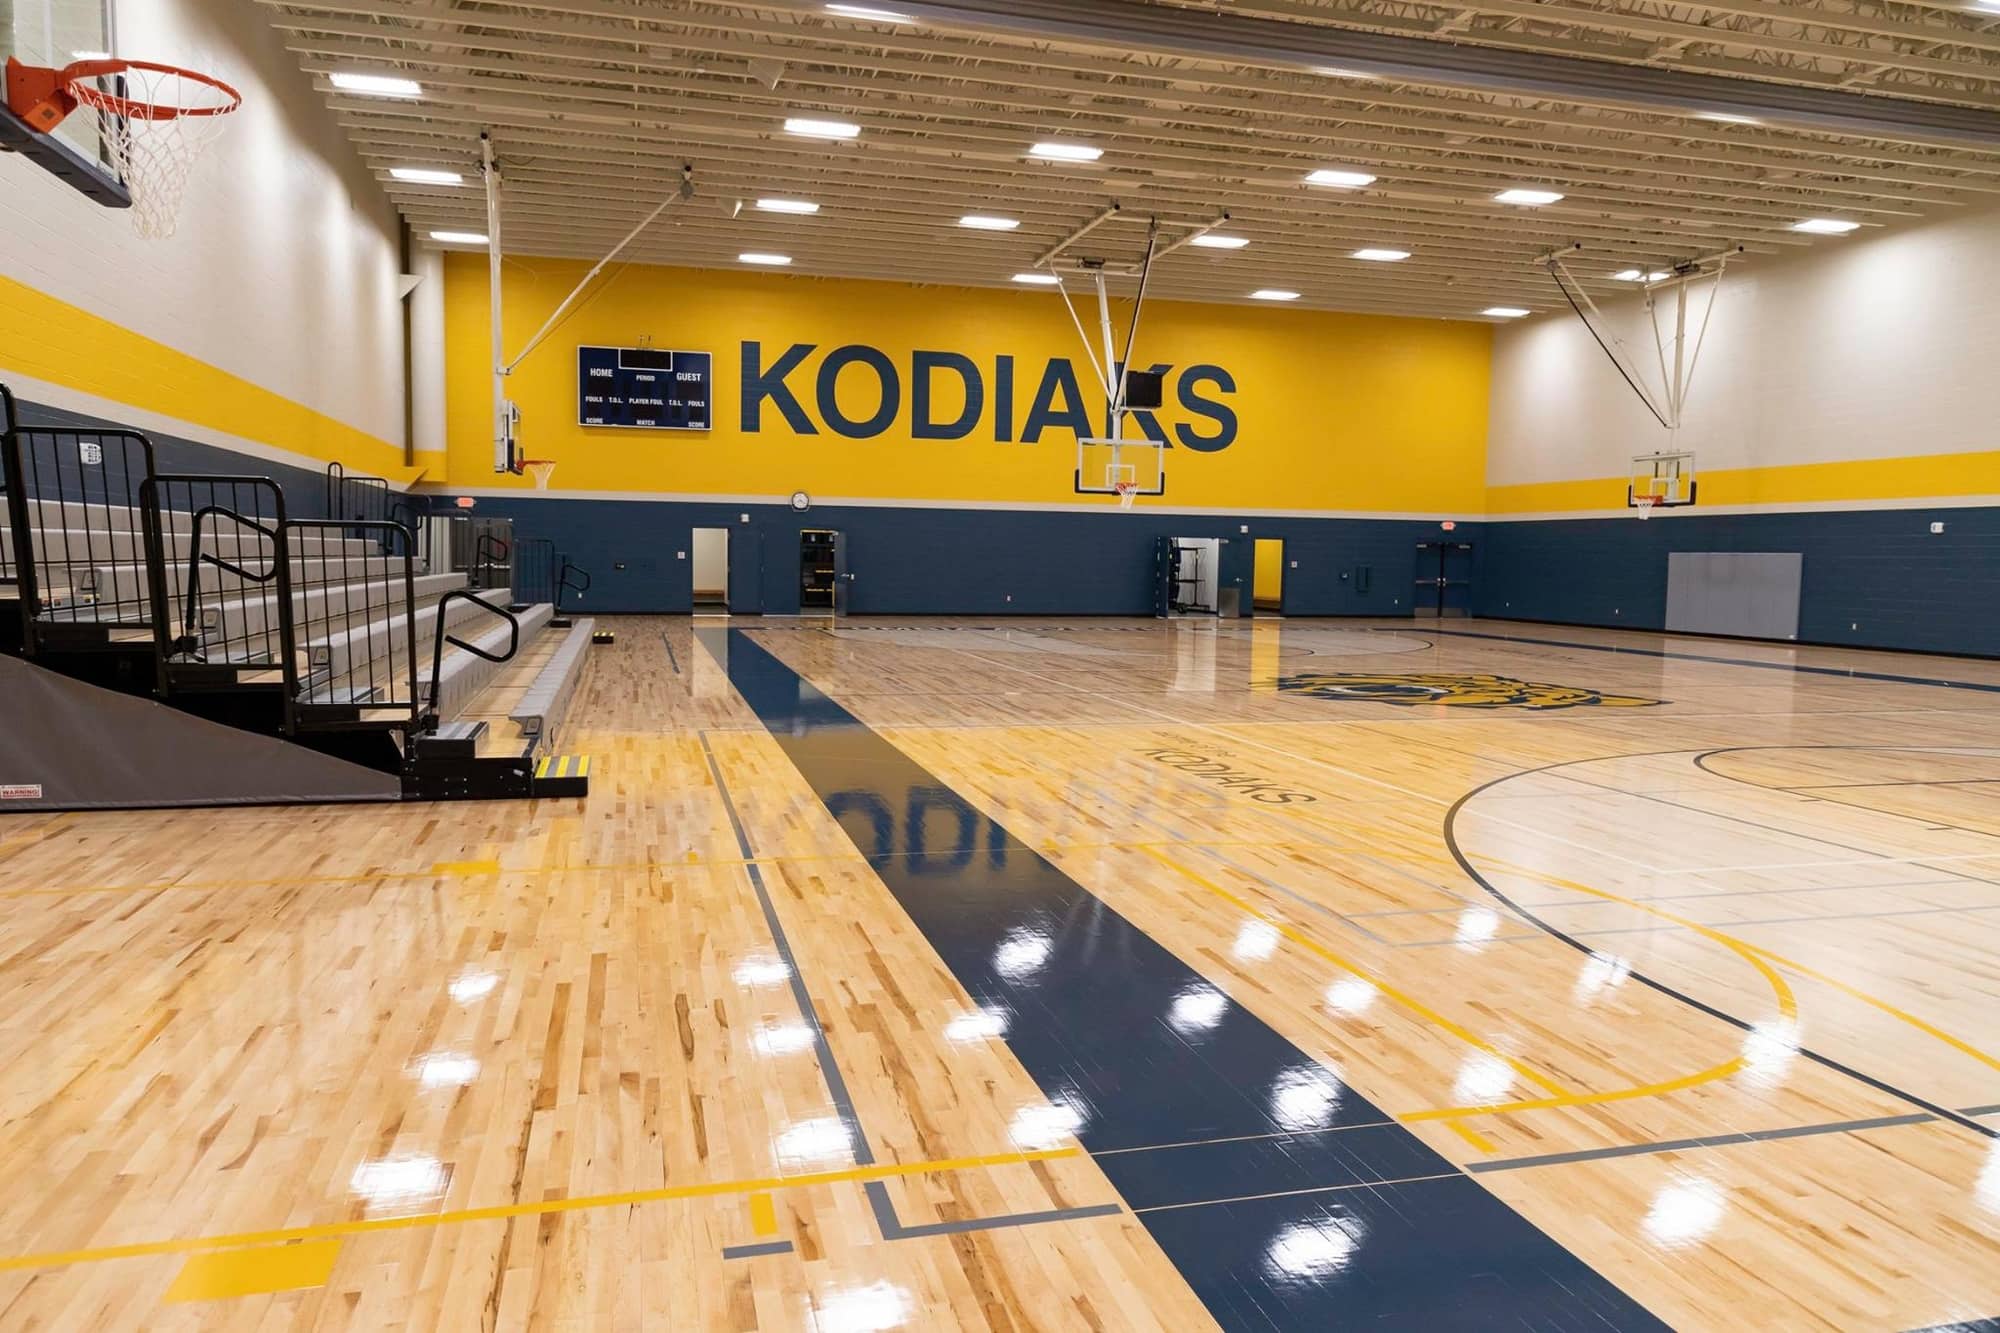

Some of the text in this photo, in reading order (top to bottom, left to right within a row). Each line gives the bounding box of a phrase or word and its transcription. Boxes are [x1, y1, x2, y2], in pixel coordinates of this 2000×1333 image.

[590, 368, 613, 377] HOME
[676, 372, 701, 381] GUEST
[741, 340, 1238, 453] KODIAKS
[1133, 748, 1318, 804] KODIAKS
